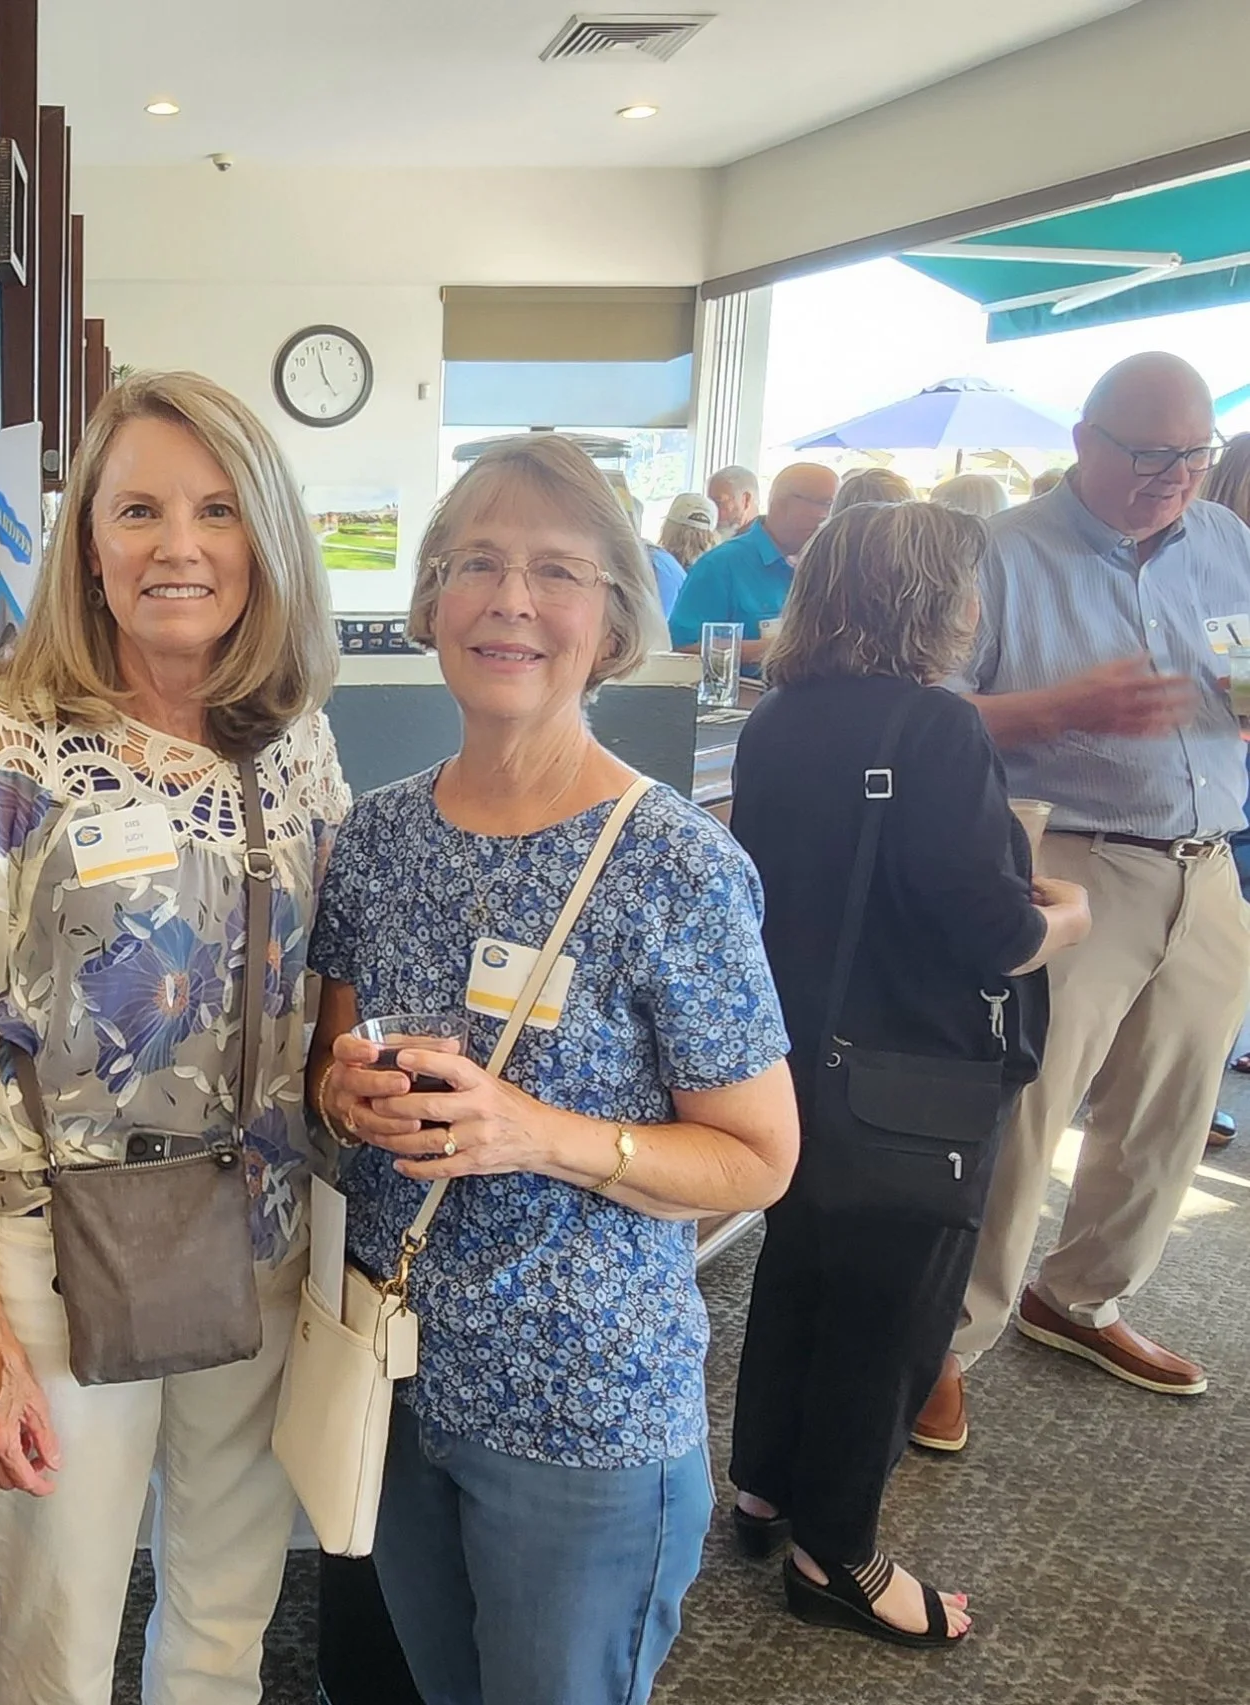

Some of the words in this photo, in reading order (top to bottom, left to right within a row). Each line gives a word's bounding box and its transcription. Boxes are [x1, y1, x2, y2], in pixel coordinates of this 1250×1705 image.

[306, 346, 315, 356] 11
[319, 341, 331, 351] 12
[295, 357, 306, 367] 10
[348, 357, 354, 367] 2
[320, 403, 327, 413] 6
